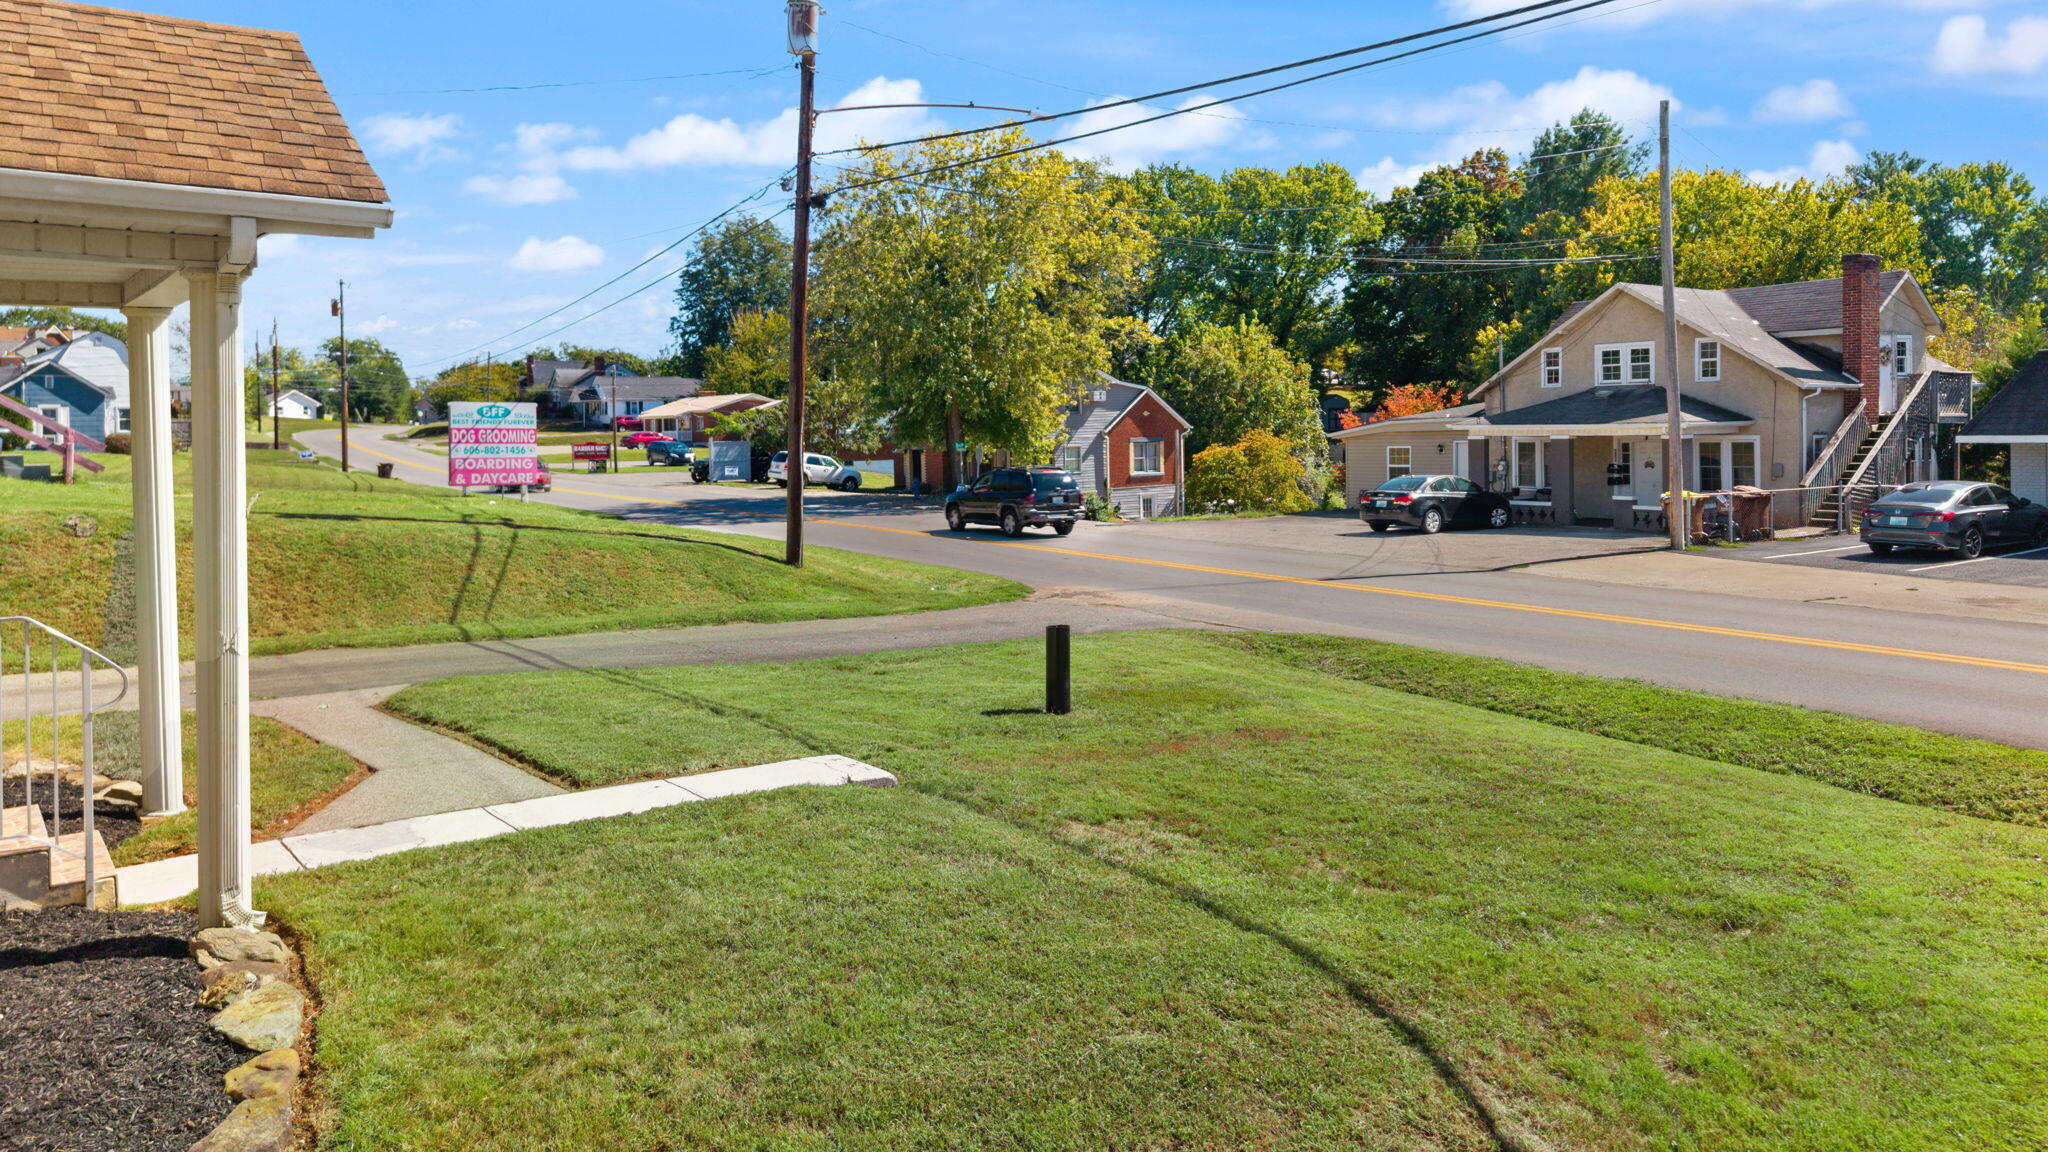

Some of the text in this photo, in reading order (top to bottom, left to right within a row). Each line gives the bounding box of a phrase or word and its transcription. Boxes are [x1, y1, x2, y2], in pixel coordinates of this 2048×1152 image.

[483, 407, 505, 417] BFF
[452, 429, 536, 443] DOG GROOMING
[463, 446, 526, 455] 606-802-1456
[455, 459, 534, 470] BOARDING
[456, 472, 533, 484] & DAYCARE
